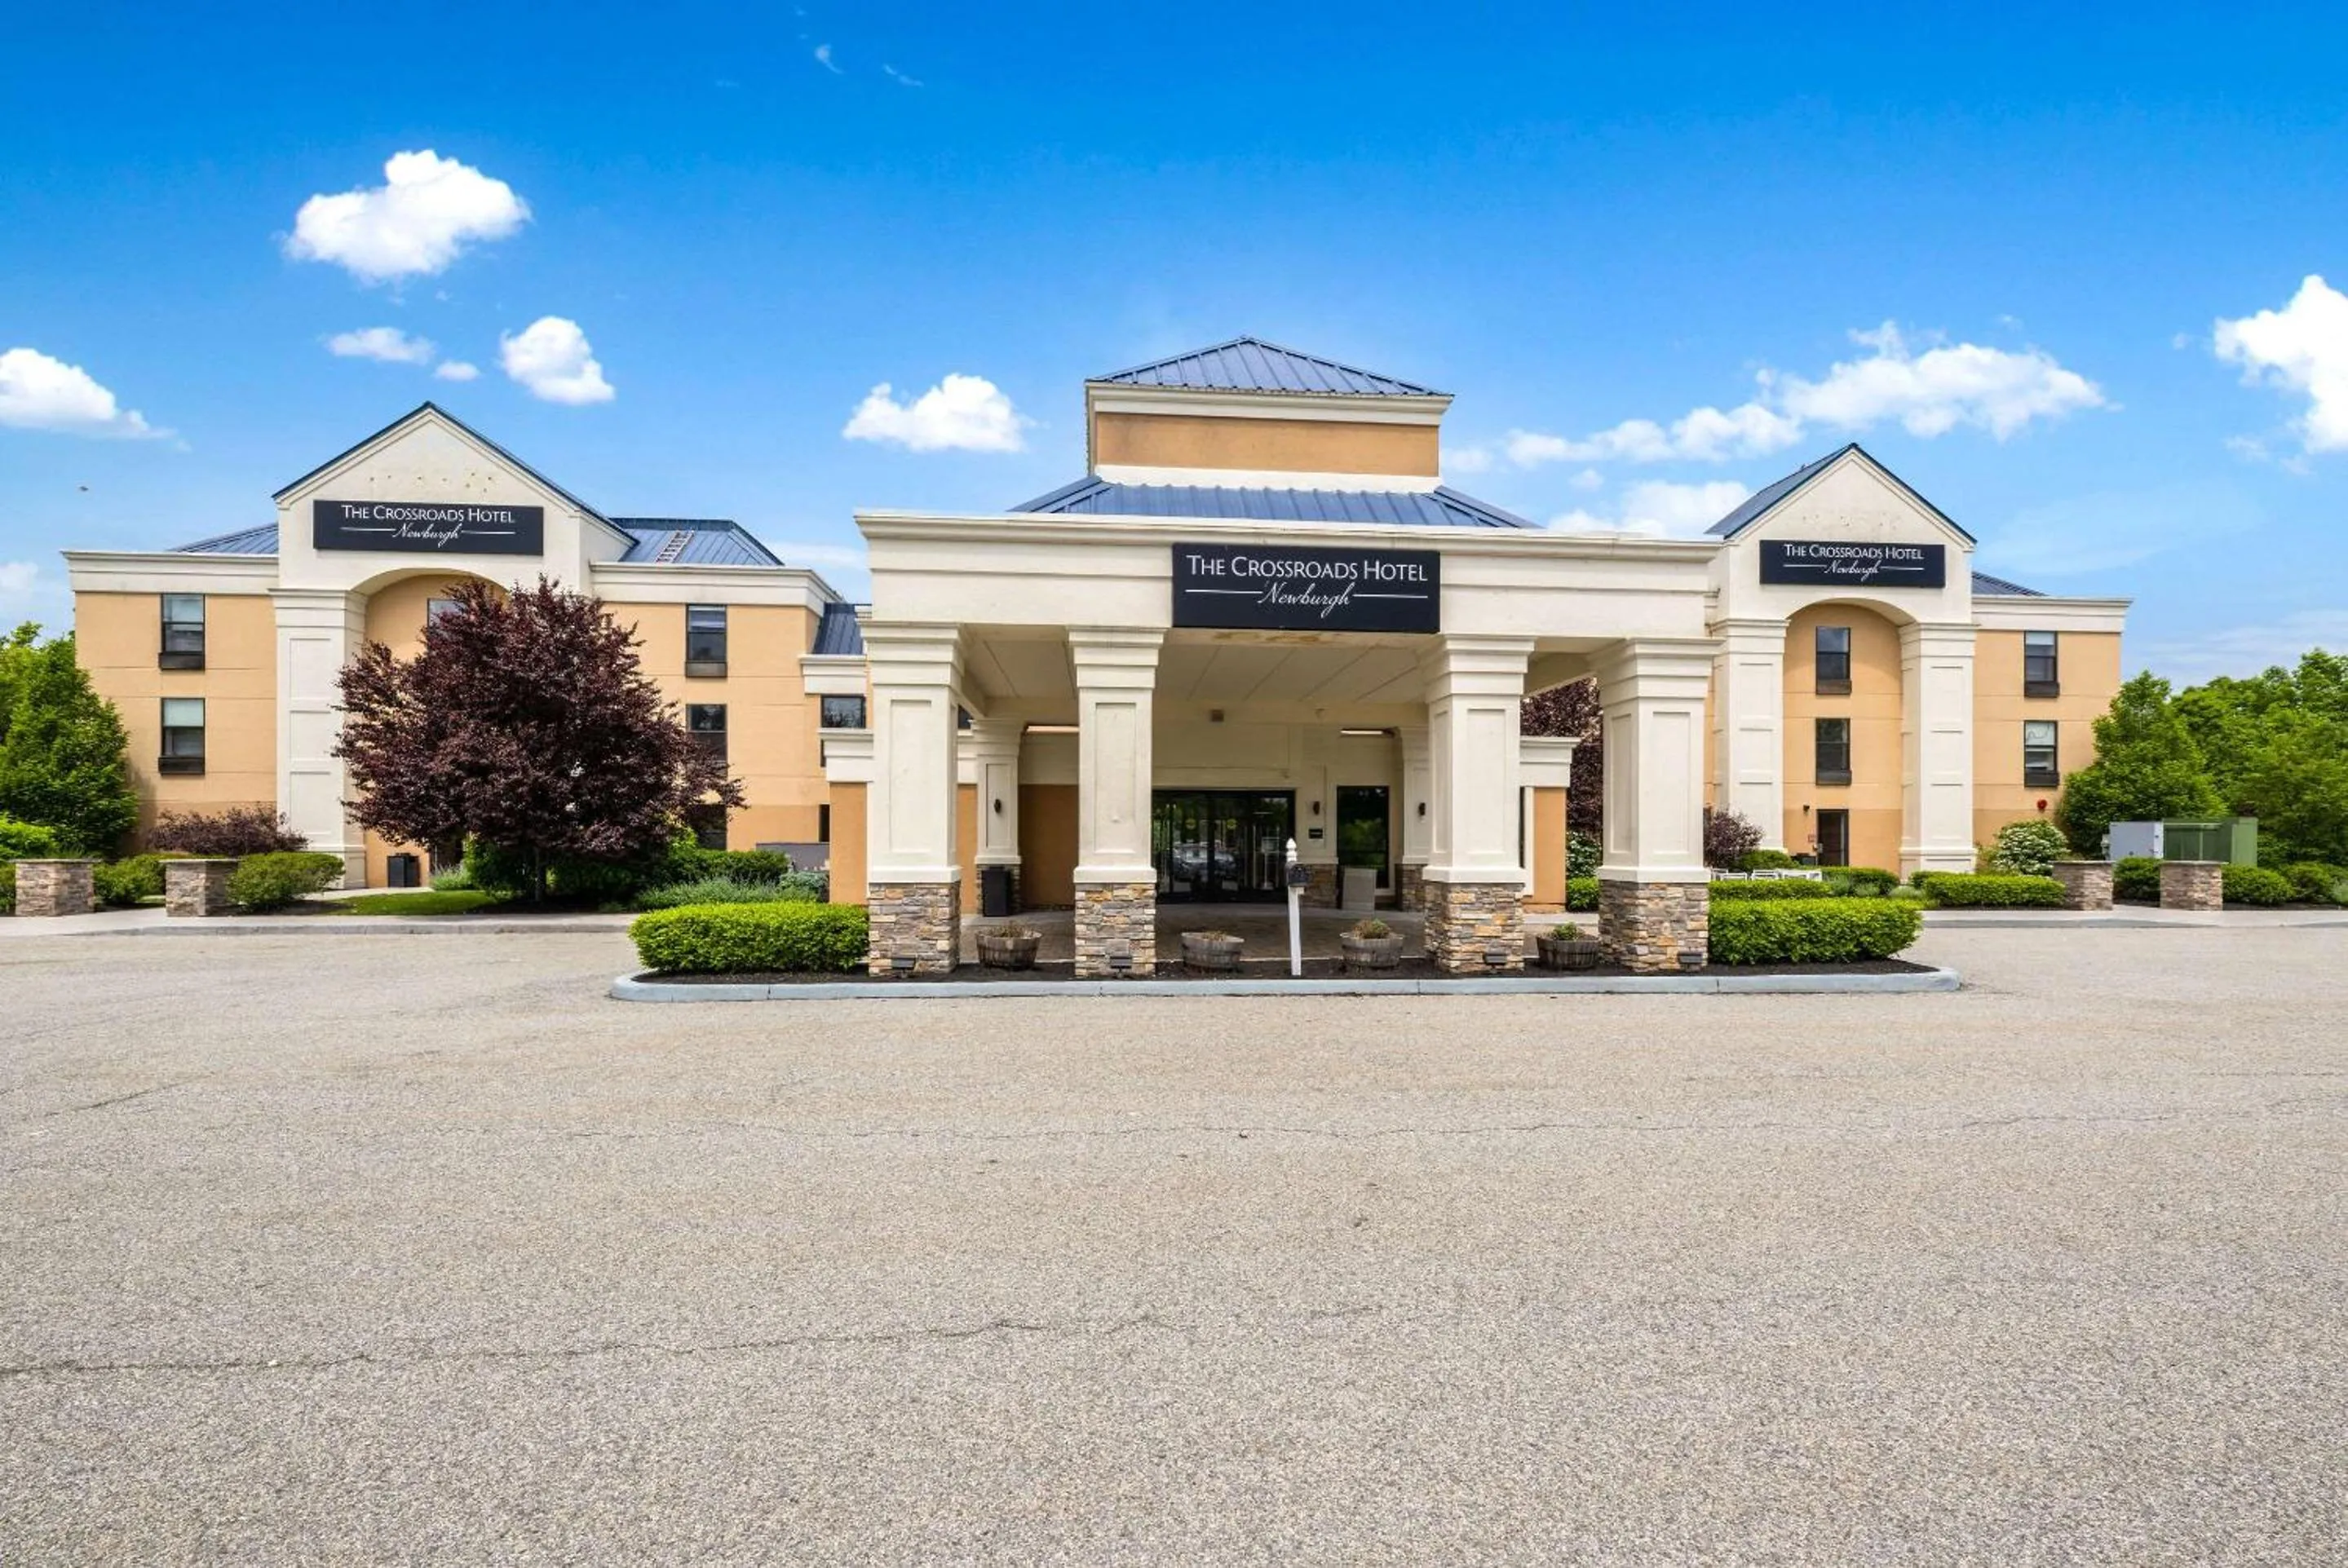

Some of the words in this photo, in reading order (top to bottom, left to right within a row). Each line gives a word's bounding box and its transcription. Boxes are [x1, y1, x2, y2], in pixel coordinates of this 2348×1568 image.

[1186, 554, 1227, 576] THE
[1231, 556, 1359, 580] CROSSROADS
[1364, 560, 1428, 581] HOTEL
[1258, 581, 1355, 619] Newburgh
